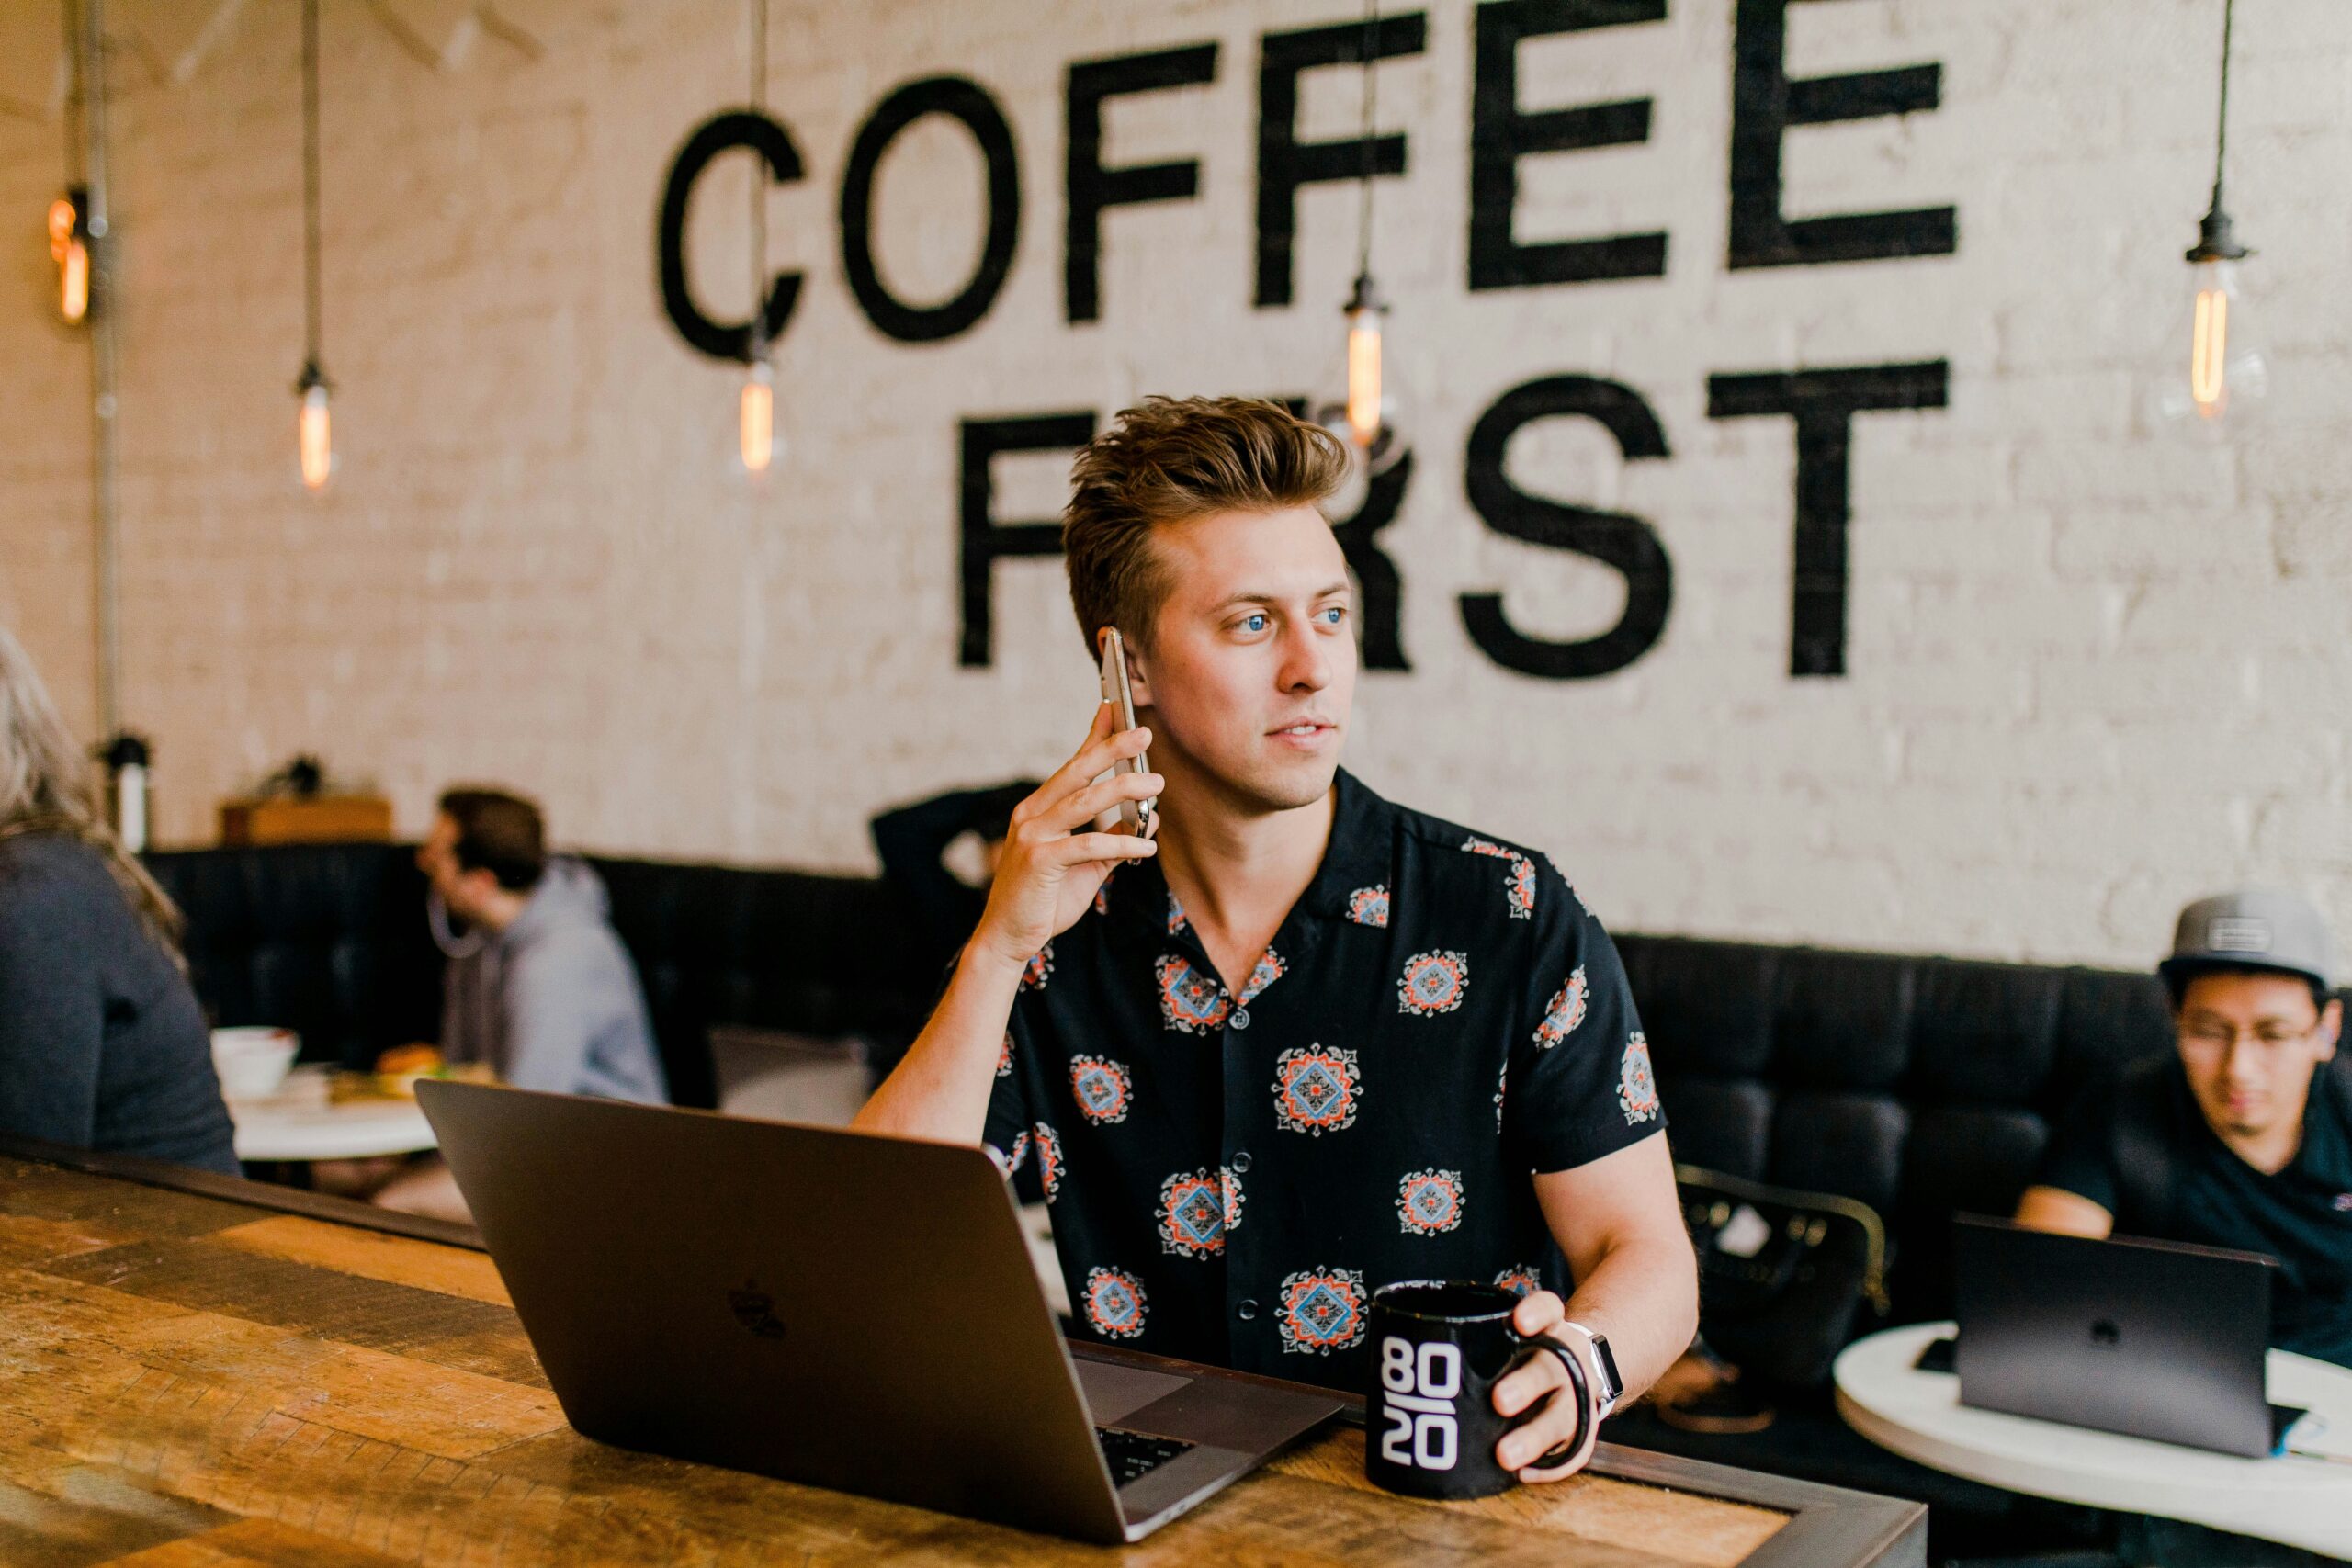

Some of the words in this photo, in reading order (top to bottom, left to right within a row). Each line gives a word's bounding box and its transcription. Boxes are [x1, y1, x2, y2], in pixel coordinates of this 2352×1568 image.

[654, 0, 1958, 362] COFFEE
[956, 359, 1950, 681] FRST
[1382, 1336, 1461, 1399] 80
[1382, 1404, 1458, 1470] 20
